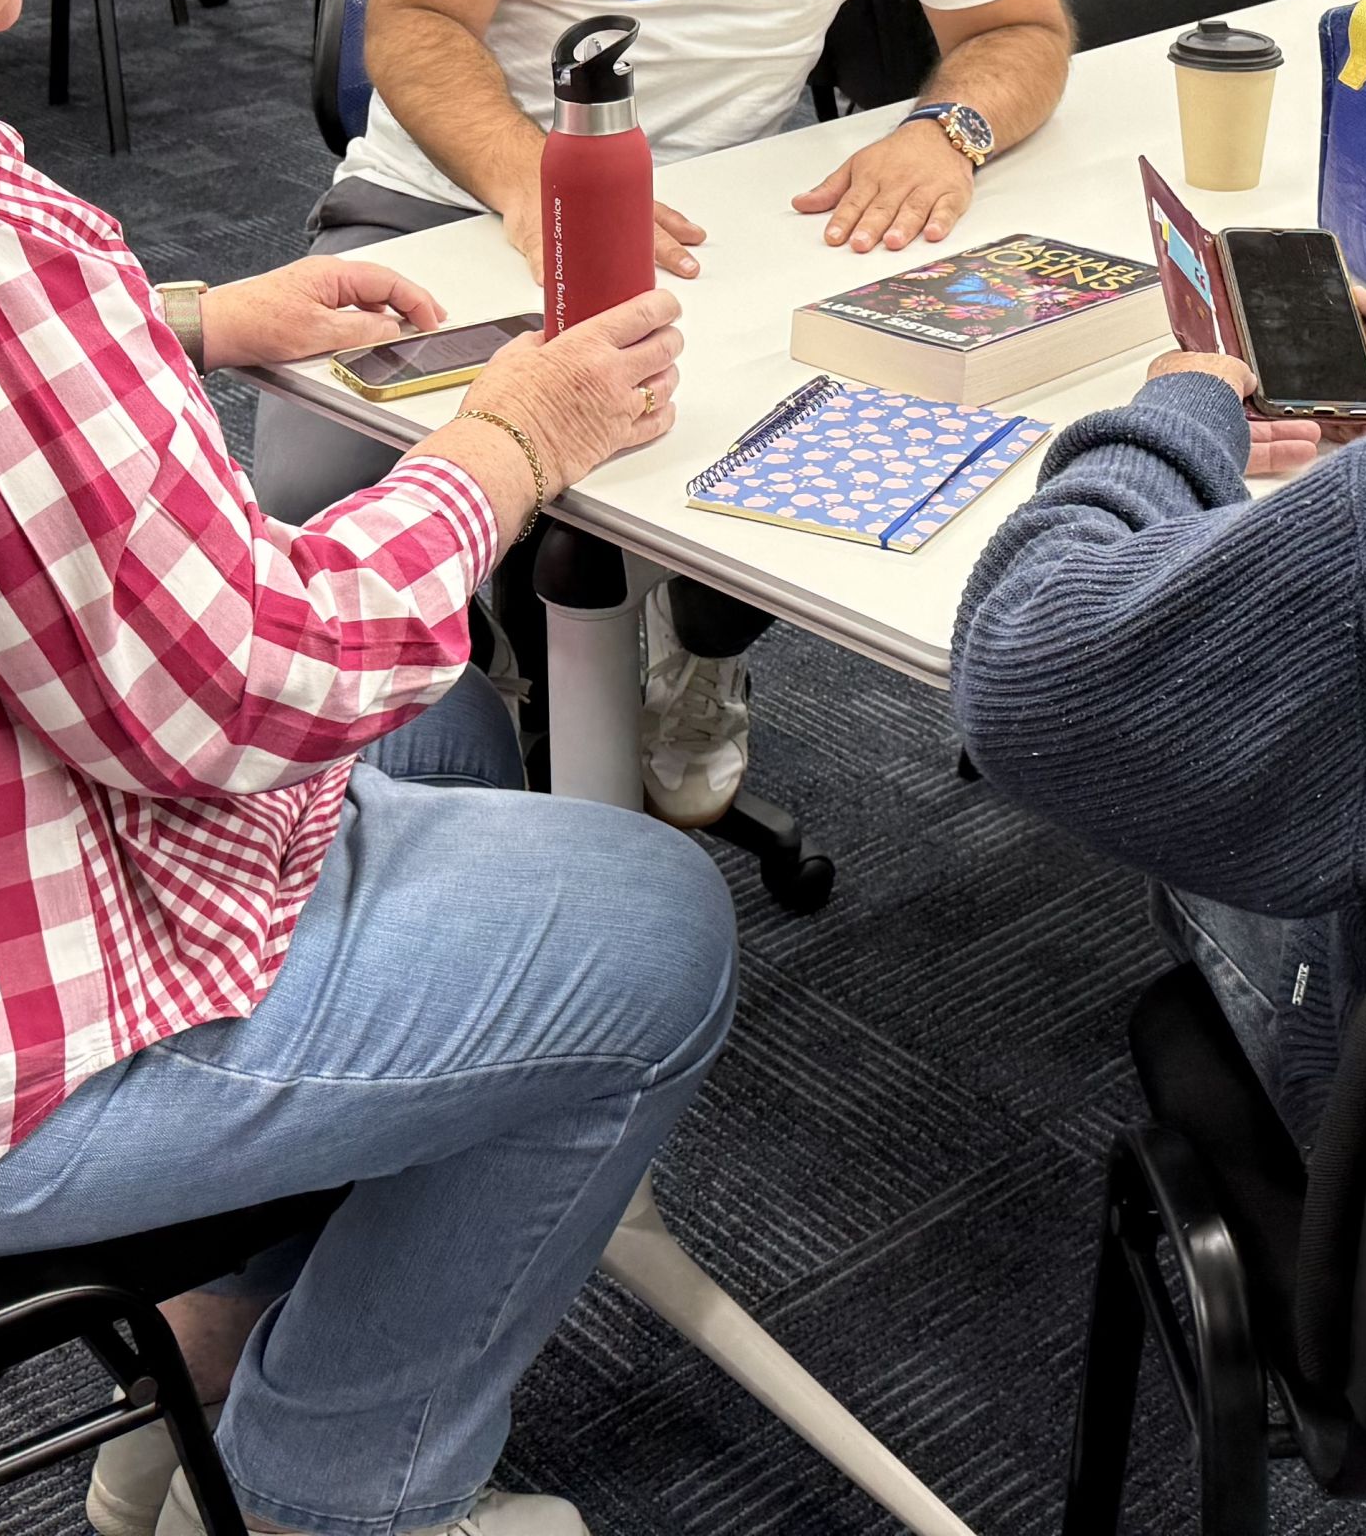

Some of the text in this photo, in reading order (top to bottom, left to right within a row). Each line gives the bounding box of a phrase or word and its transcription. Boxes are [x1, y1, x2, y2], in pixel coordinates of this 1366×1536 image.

[553, 197, 563, 241] Service
[554, 240, 564, 280] Doctor
[960, 248, 1126, 292] JOHNS
[1008, 239, 1145, 283] RACHAEL
[554, 281, 566, 318] Flying
[821, 301, 971, 343] LUCKY SISTERS
